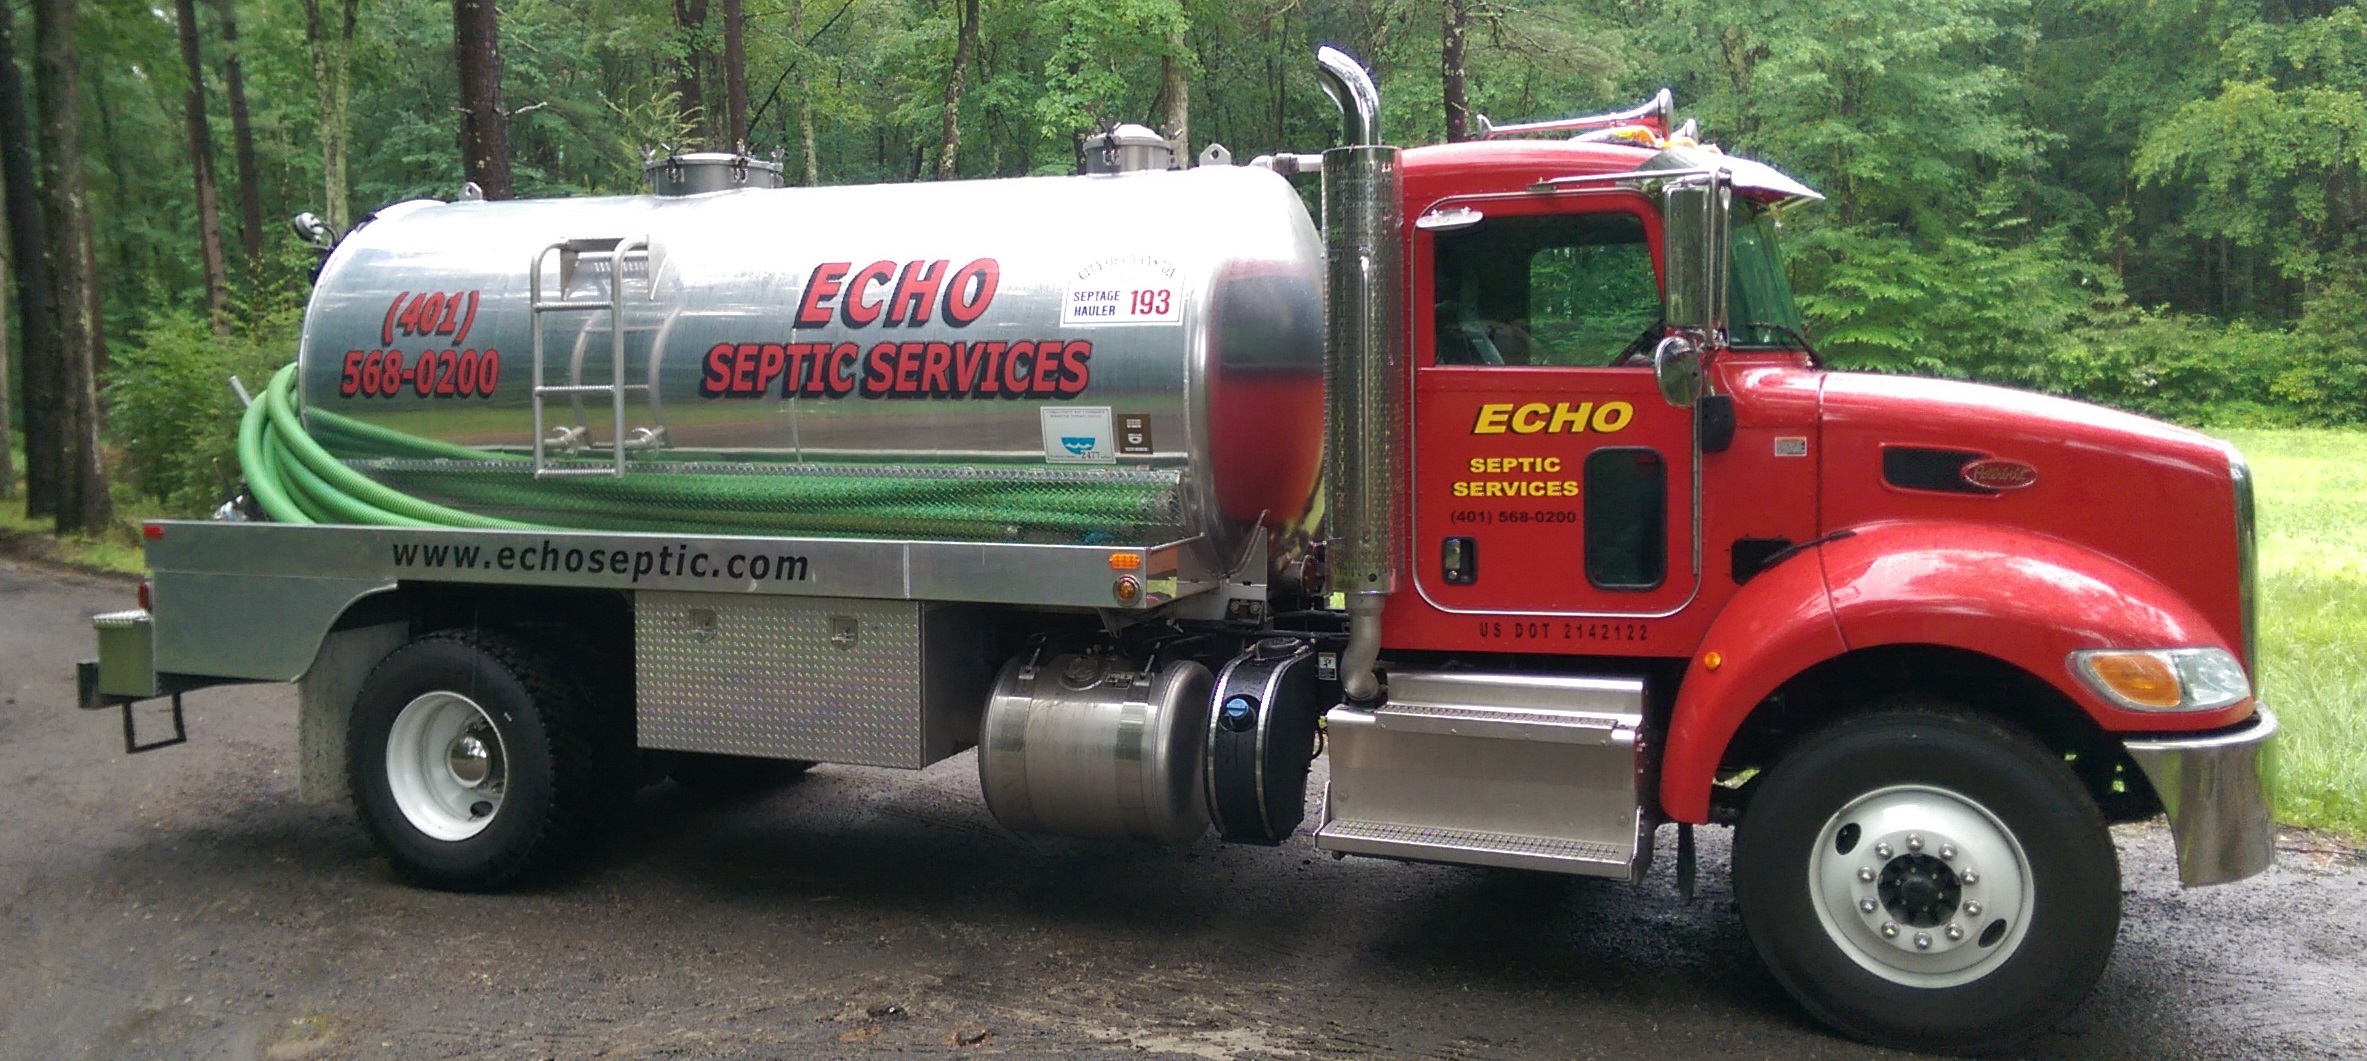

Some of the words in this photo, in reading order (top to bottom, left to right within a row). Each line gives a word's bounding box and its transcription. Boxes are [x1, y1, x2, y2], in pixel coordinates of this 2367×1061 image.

[793, 257, 1000, 329] ECHO
[1073, 290, 1121, 302] SEPTAGE
[1130, 289, 1171, 315] 193
[382, 290, 480, 347] (401)
[1074, 305, 1116, 317] HAULER
[340, 348, 500, 398] 568-0200
[701, 341, 861, 400] SEPTIC
[861, 339, 1093, 401] SERVICES
[1472, 401, 1634, 436] ECHO
[1469, 457, 1561, 473] SEPTIC
[1452, 481, 1579, 497] SERVICES
[1450, 511, 1493, 525] (401)
[1499, 511, 1577, 524] 568-0200
[393, 540, 809, 582] www.echoseptic.com
[1480, 623, 1501, 638] US
[1515, 623, 1550, 639] DOT
[1564, 624, 1648, 641] 2142122
